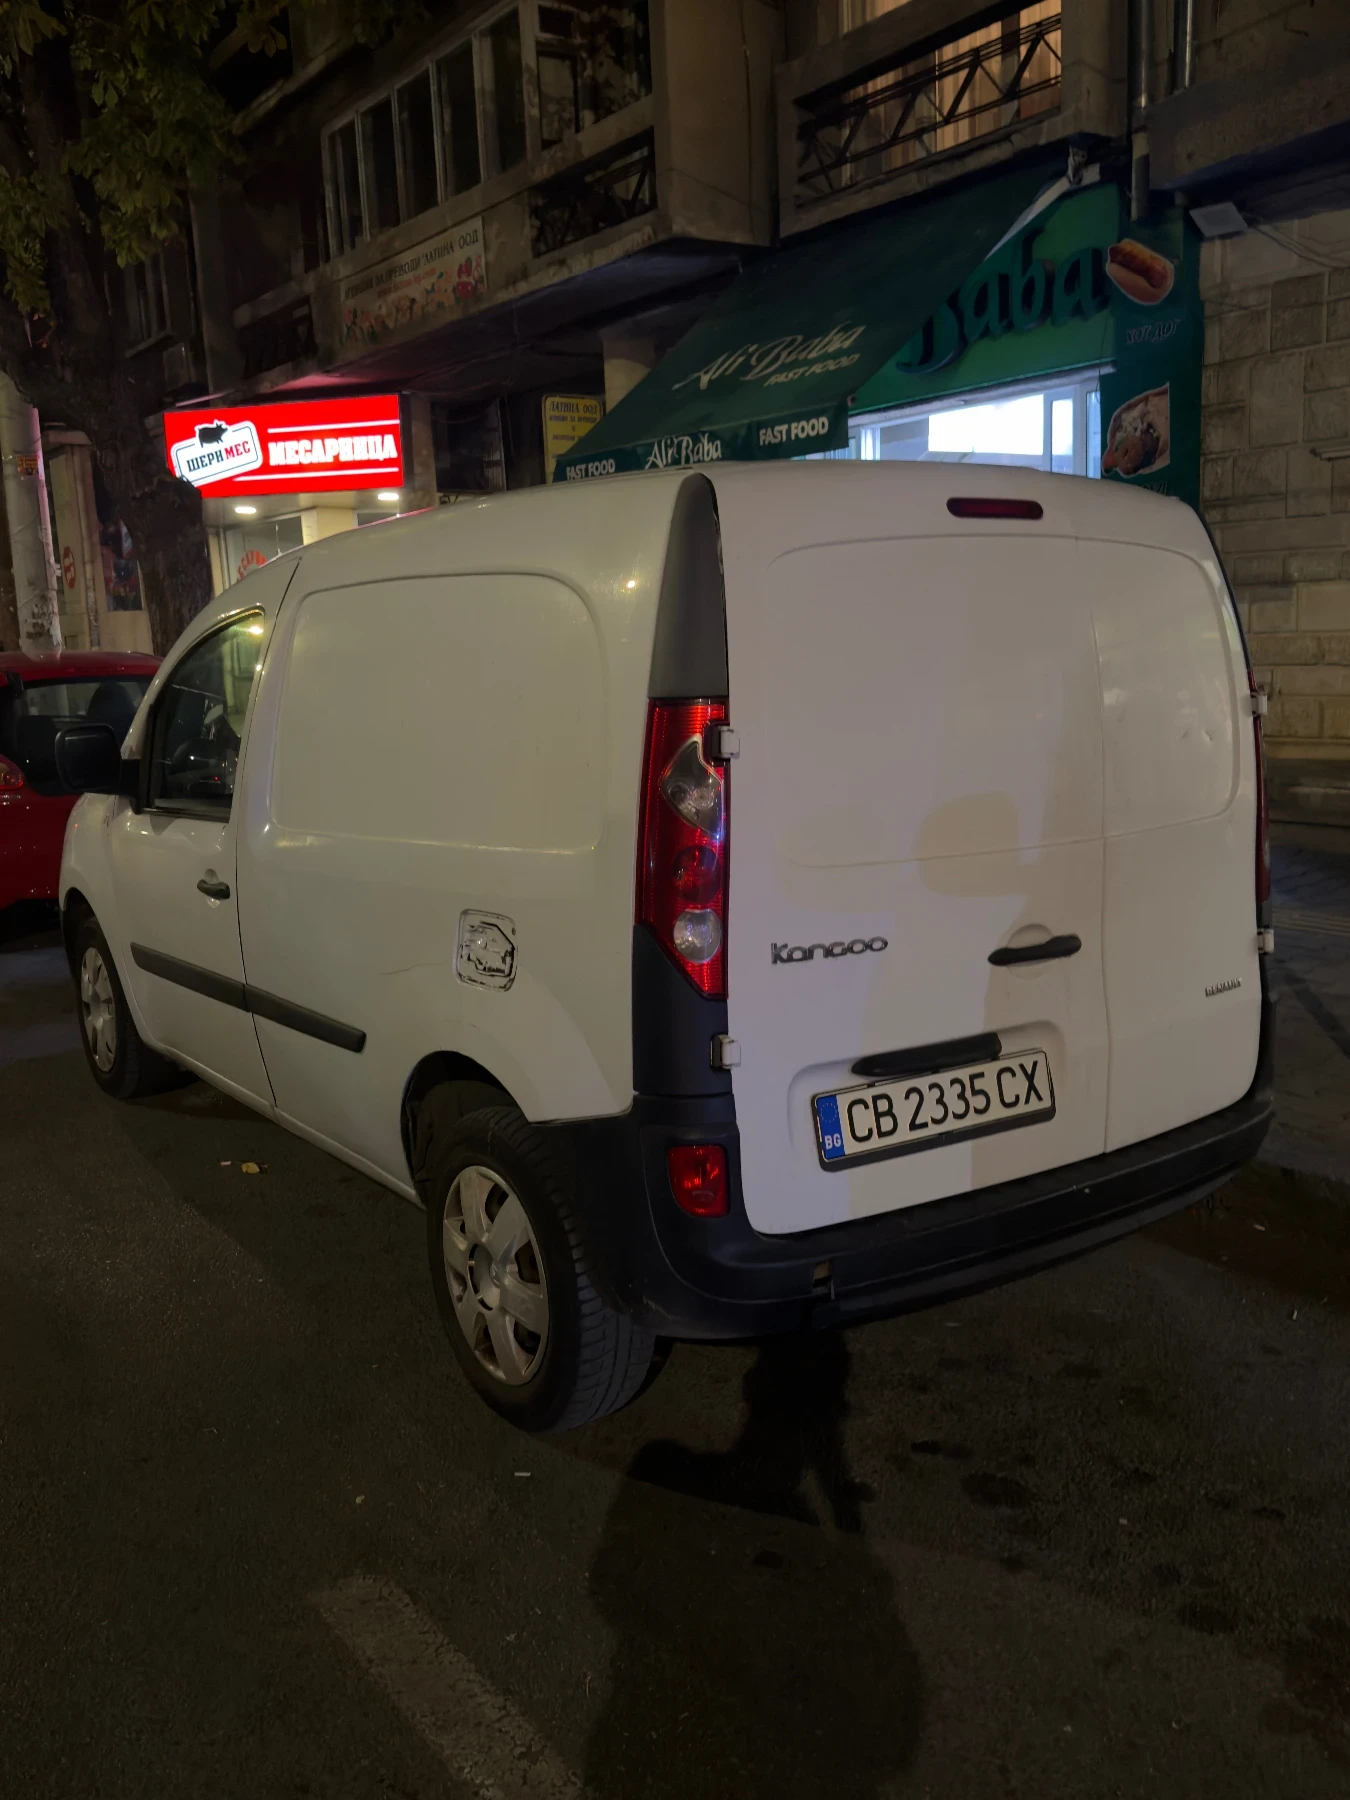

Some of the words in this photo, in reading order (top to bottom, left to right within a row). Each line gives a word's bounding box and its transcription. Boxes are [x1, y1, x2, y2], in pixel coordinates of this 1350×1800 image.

[458, 229, 479, 250] ООД
[739, 319, 867, 381] Baba
[763, 366, 811, 388] FAST
[804, 353, 861, 377] FOOD
[759, 423, 789, 447] FAST
[790, 416, 829, 441] FOOD
[267, 434, 399, 466] МЕСАРНИЦА
[565, 463, 586, 480] FAST
[588, 458, 616, 477] FOOD
[846, 1093, 899, 1143] CB
[904, 1071, 992, 1132] 2335
[996, 1060, 1044, 1109] CX
[824, 1133, 842, 1150] BG
